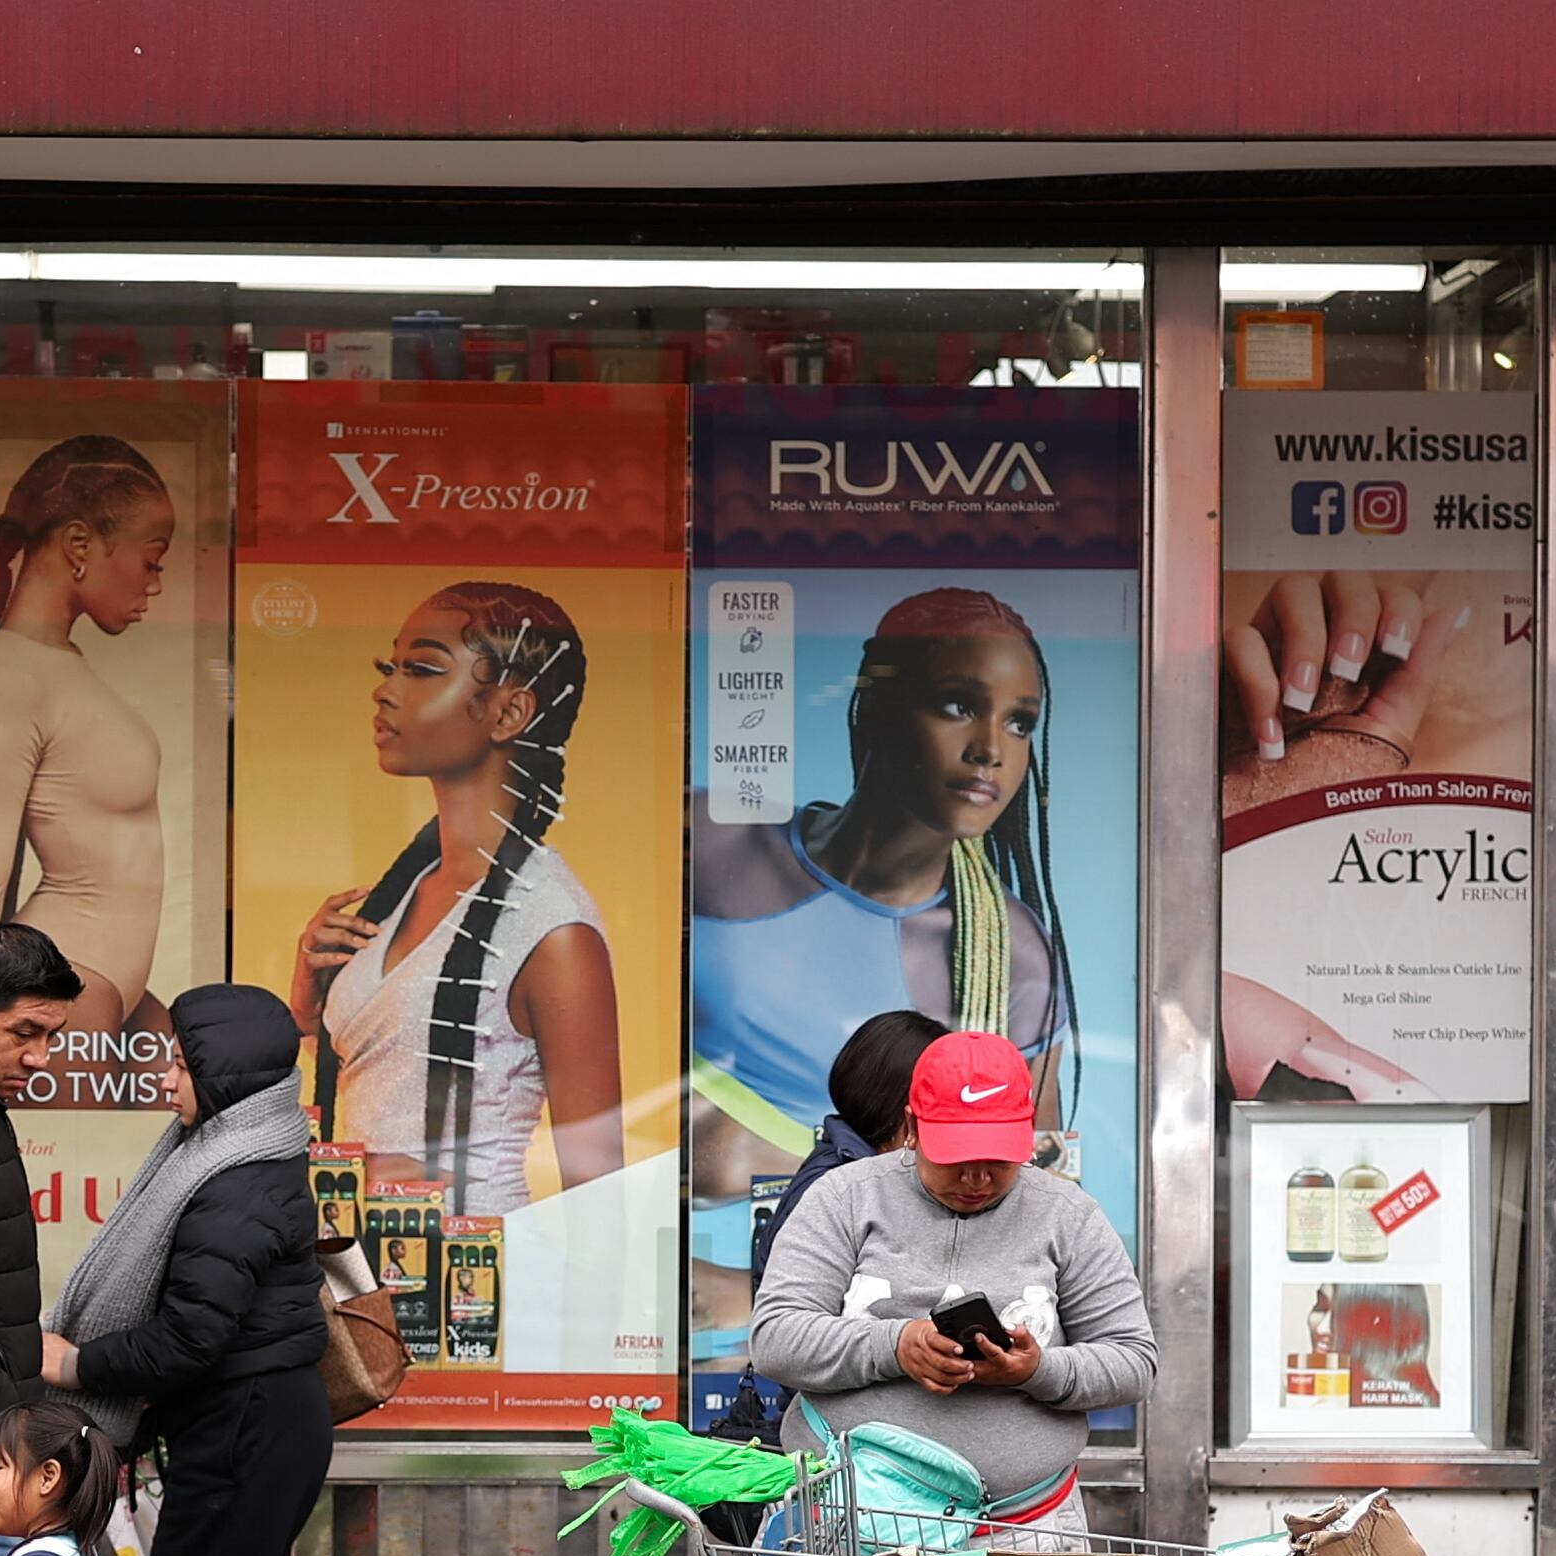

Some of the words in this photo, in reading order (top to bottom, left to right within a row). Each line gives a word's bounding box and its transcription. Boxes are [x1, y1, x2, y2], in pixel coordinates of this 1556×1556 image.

[347, 426, 445, 438] SENSATIONNEL
[1275, 427, 1528, 462] www.kissusa
[770, 439, 1054, 496] RUWA
[327, 452, 591, 524] X-Pression
[770, 501, 805, 511] Made
[808, 501, 841, 511] With
[909, 501, 943, 511] Fiber
[947, 502, 982, 512] From
[1434, 495, 1533, 530] #kiss
[722, 592, 780, 611] FASTER
[727, 613, 776, 621] DRYING
[718, 672, 784, 690] LIGHTER
[727, 693, 776, 701] WEIGHT
[714, 745, 788, 763] SMARTER
[733, 765, 769, 774] FIBER
[1325, 783, 1382, 809] Better
[1386, 780, 1433, 799] Than
[1437, 779, 1488, 799] Salon
[1364, 827, 1413, 845] Salon
[1328, 828, 1529, 901] Acrylic
[1461, 887, 1528, 902] FRENCH
[1306, 963, 1350, 976] Natural
[1353, 963, 1382, 976] Look
[1385, 964, 1394, 976] &
[1396, 963, 1451, 976] Seamless
[1453, 963, 1493, 976] Cuticle
[1495, 963, 1523, 976] Line
[1342, 991, 1374, 1006] Mega
[1376, 991, 1396, 1004] Gel
[1399, 991, 1432, 1004] Shine
[1392, 1028, 1426, 1041] Never
[1428, 1027, 1457, 1043] Chip
[1459, 1027, 1489, 1043] Deep
[1491, 1027, 1527, 1041] White
[47, 1030, 176, 1063] PRINGY
[453, 1342, 491, 1357] kids
[614, 1336, 664, 1349] AFRICAN
[1361, 1392, 1390, 1404] HAIR
[1391, 1392, 1424, 1404] MASK
